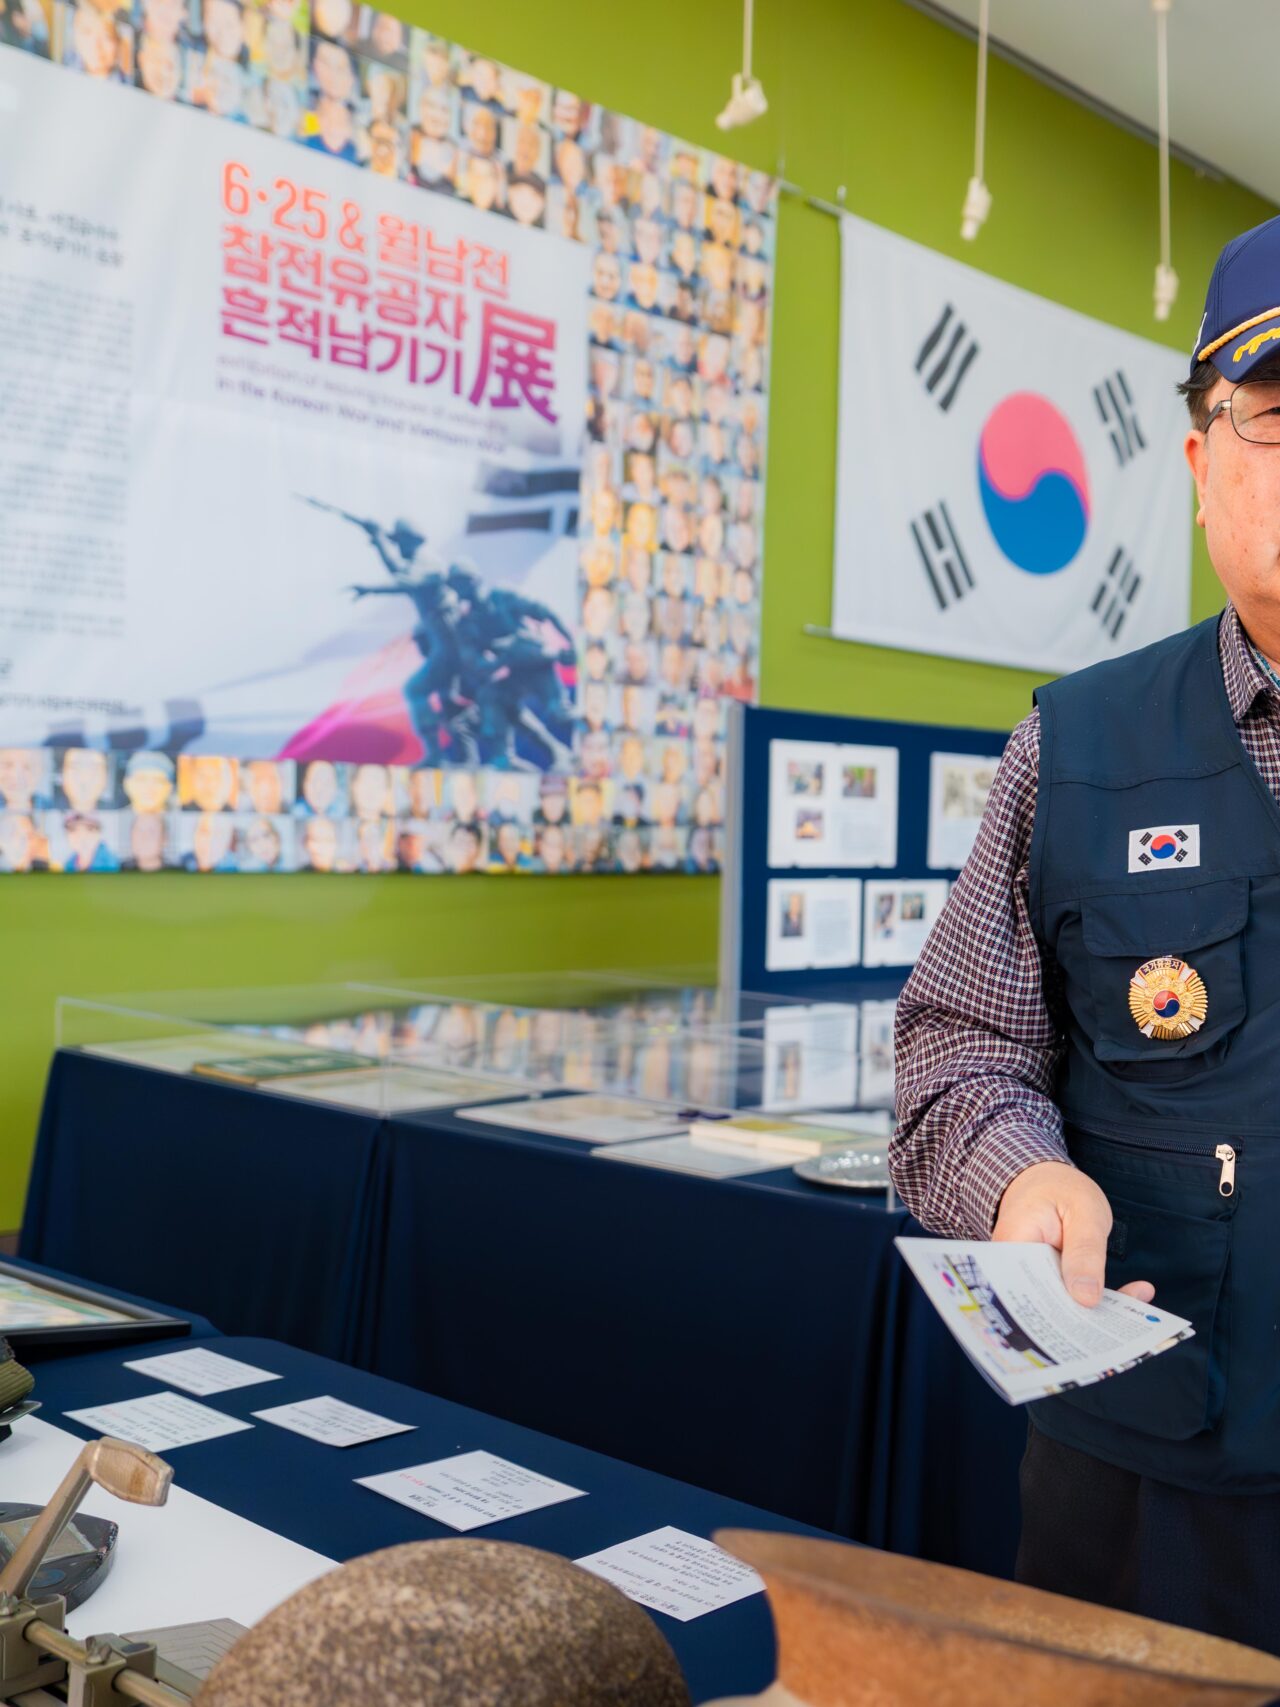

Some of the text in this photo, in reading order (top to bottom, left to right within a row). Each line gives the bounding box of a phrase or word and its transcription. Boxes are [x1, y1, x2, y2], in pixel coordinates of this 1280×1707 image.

[222, 223, 468, 341] 참전유공자
[338, 201, 367, 253] &
[377, 213, 510, 300] 월남전
[468, 299, 560, 425] 展
